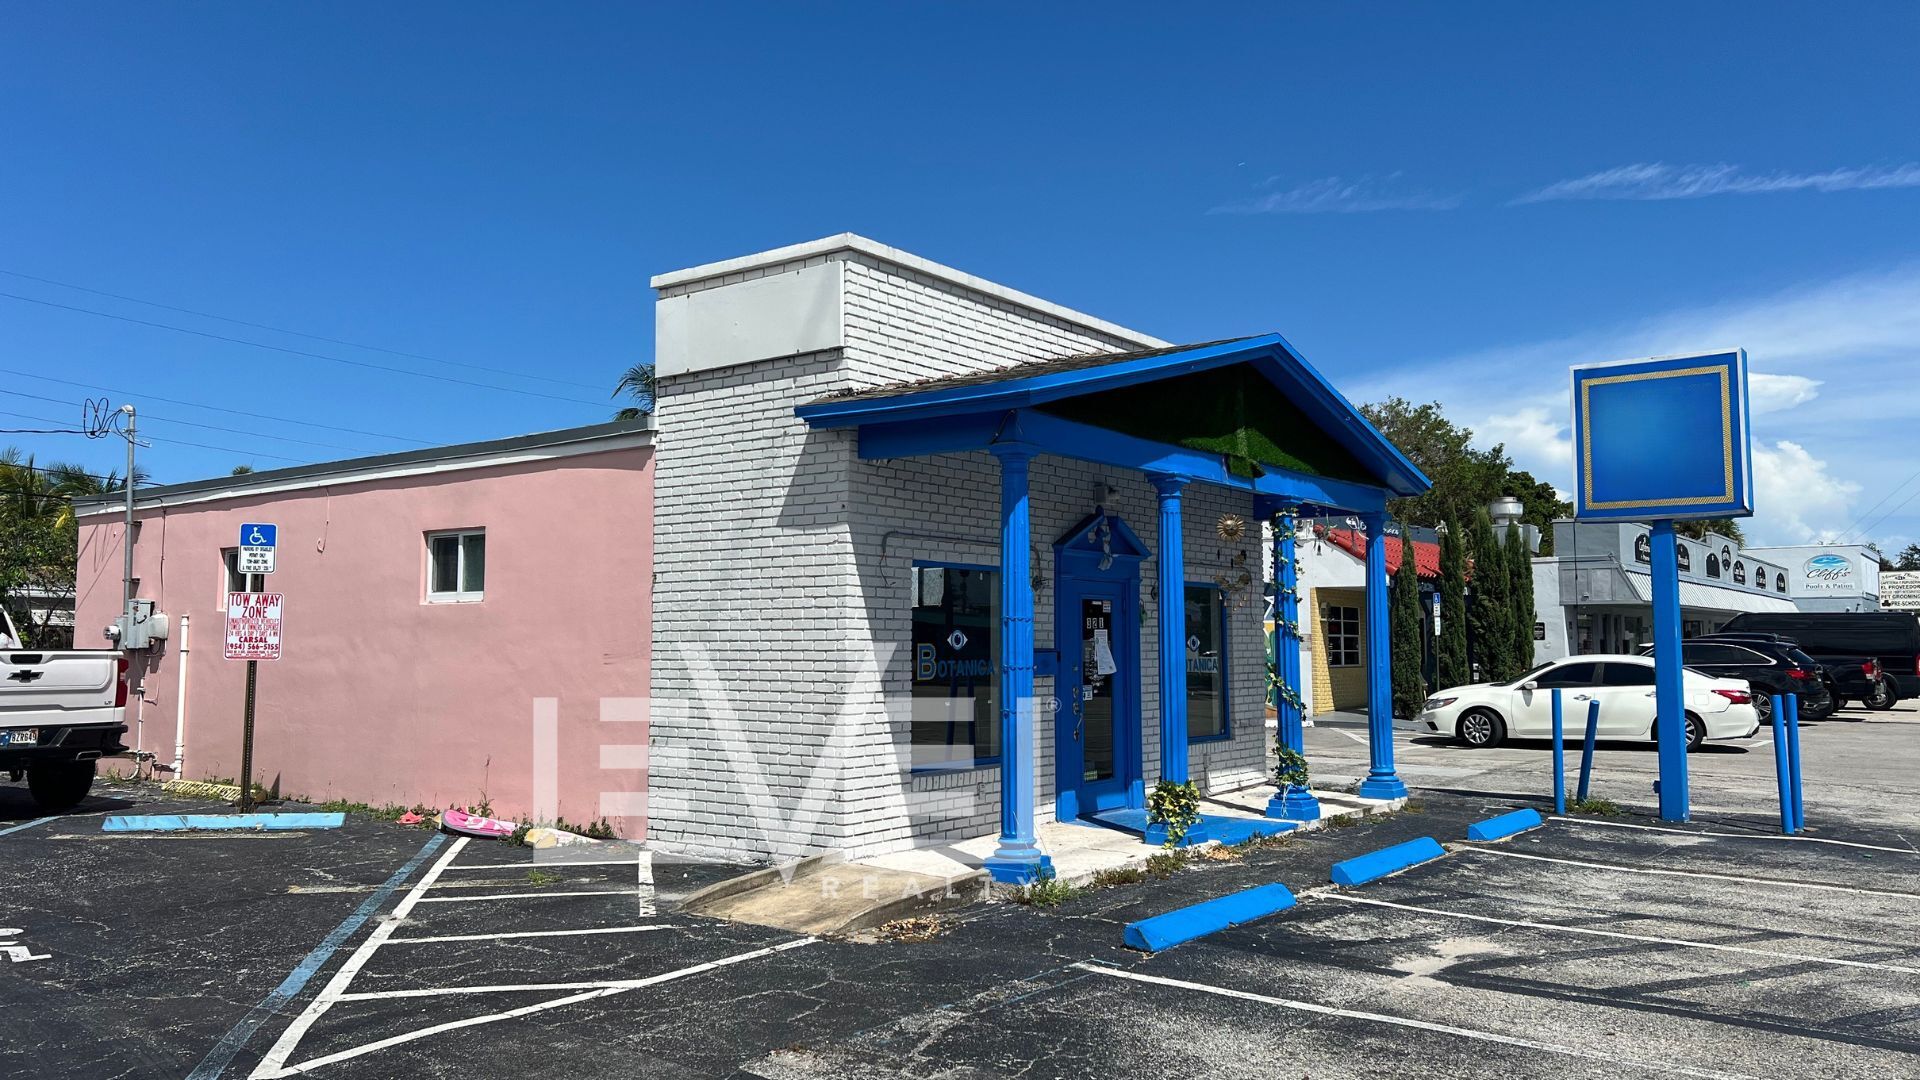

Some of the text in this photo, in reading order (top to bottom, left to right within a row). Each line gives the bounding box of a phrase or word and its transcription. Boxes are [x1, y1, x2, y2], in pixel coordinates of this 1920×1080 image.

[1806, 567, 1851, 580] Cliff's
[230, 593, 281, 607] TOW AWAY
[242, 606, 268, 618] ZONE
[1186, 658, 1219, 672] TANICA
